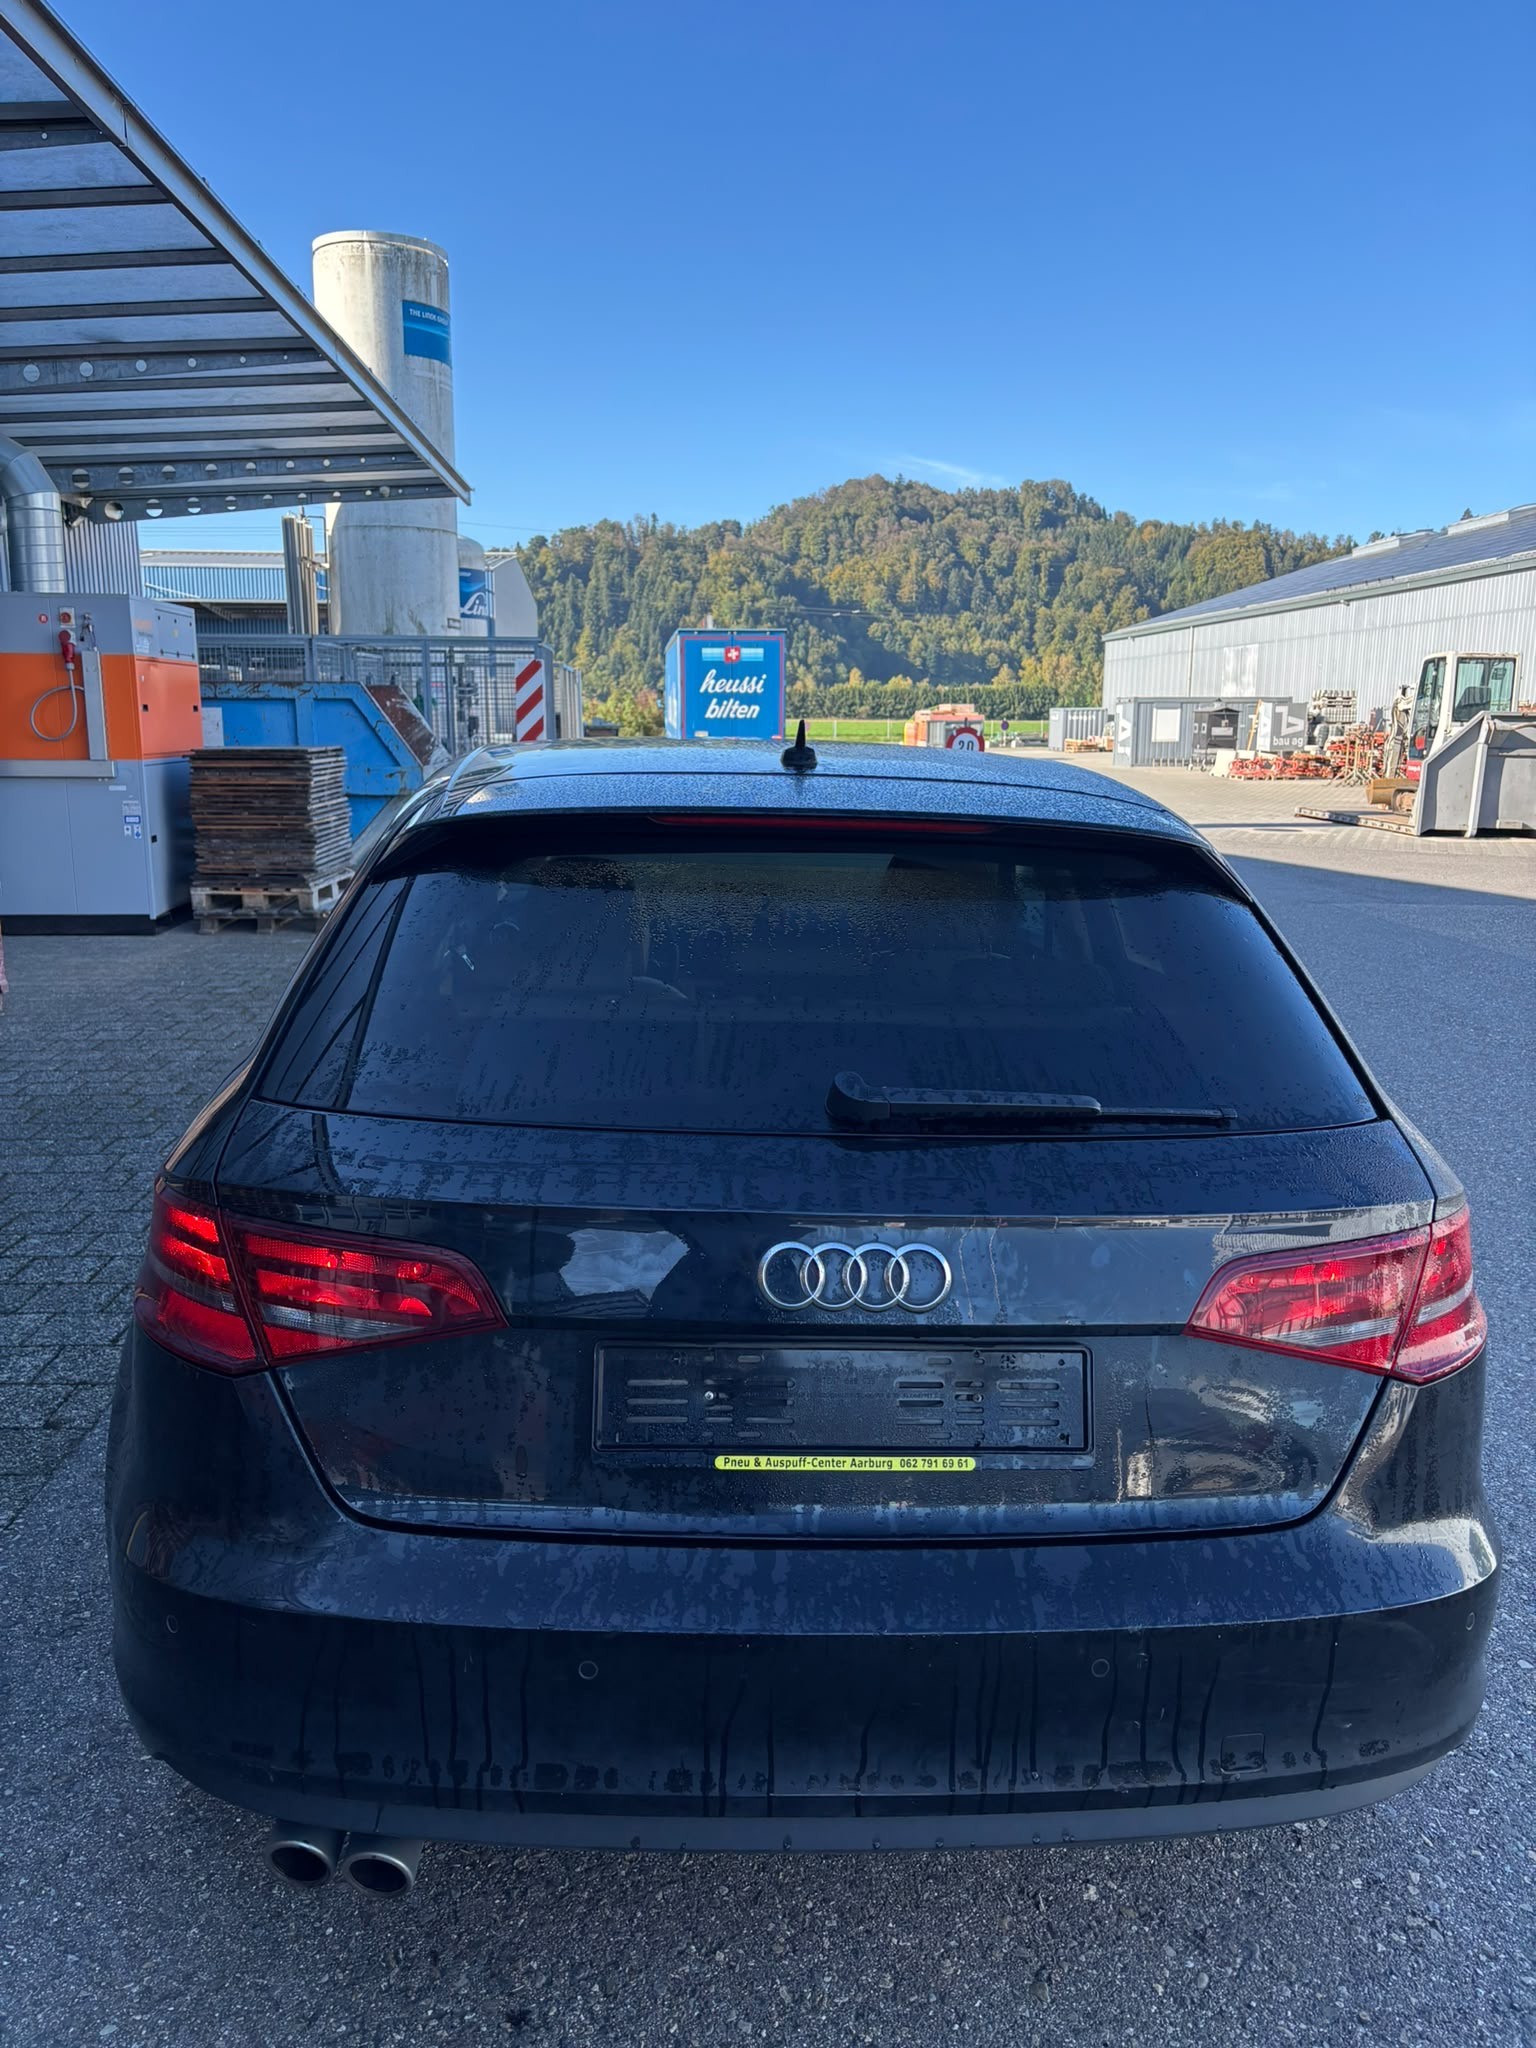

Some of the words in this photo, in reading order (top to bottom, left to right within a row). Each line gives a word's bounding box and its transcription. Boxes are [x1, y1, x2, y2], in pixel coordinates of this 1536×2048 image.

[699, 668, 767, 694] heussi
[704, 698, 761, 719] bilten
[1272, 735, 1290, 746] bau
[1291, 737, 1304, 748] ag
[723, 1457, 750, 1467] Pneu
[753, 1457, 761, 1468] &
[765, 1456, 847, 1469] Auspuff-Center
[850, 1458, 893, 1469] Aarburg
[899, 1458, 919, 1468] 062
[921, 1459, 939, 1468] 791
[942, 1459, 955, 1468] 69
[957, 1459, 969, 1468] 61
